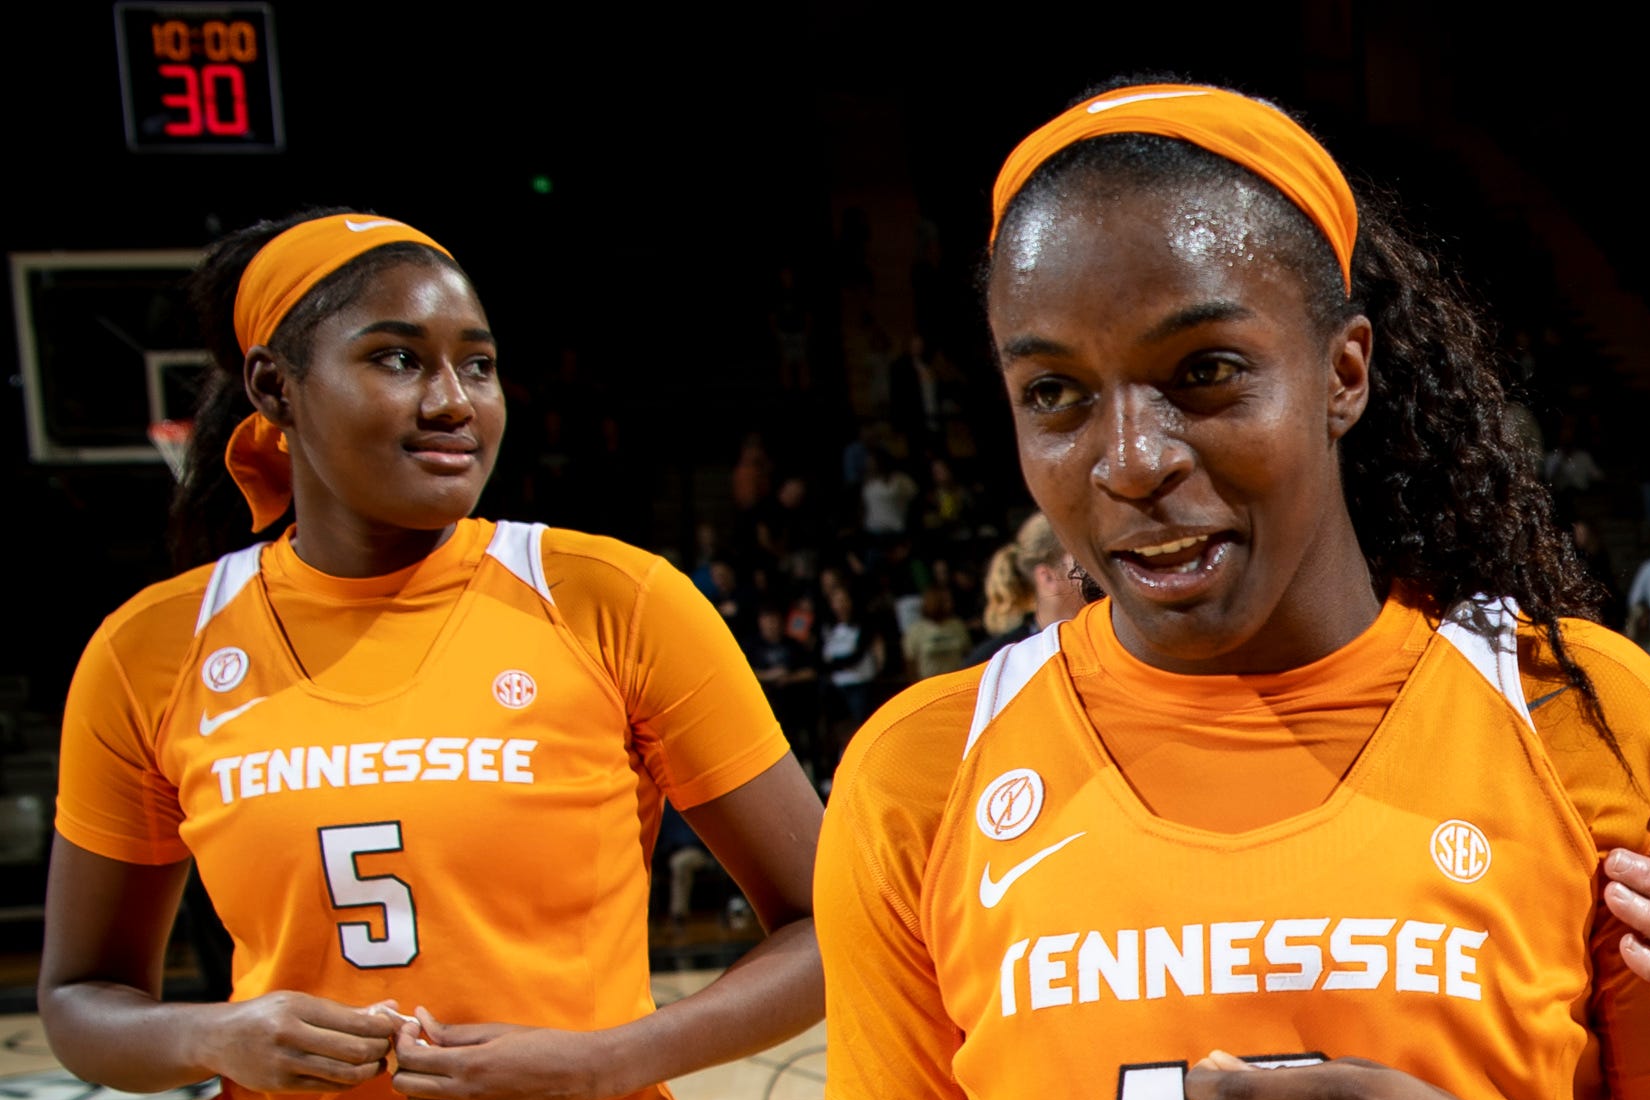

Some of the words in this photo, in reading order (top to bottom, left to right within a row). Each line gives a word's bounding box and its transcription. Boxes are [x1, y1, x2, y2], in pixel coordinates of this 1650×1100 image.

[151, 20, 257, 62] 10:00
[158, 64, 249, 136] 30
[498, 673, 533, 705] SEC
[211, 738, 538, 804] TENNESSEE
[1438, 825, 1486, 877] SEC
[317, 820, 420, 970] 5
[1000, 917, 1489, 1017] TENNESSEE
